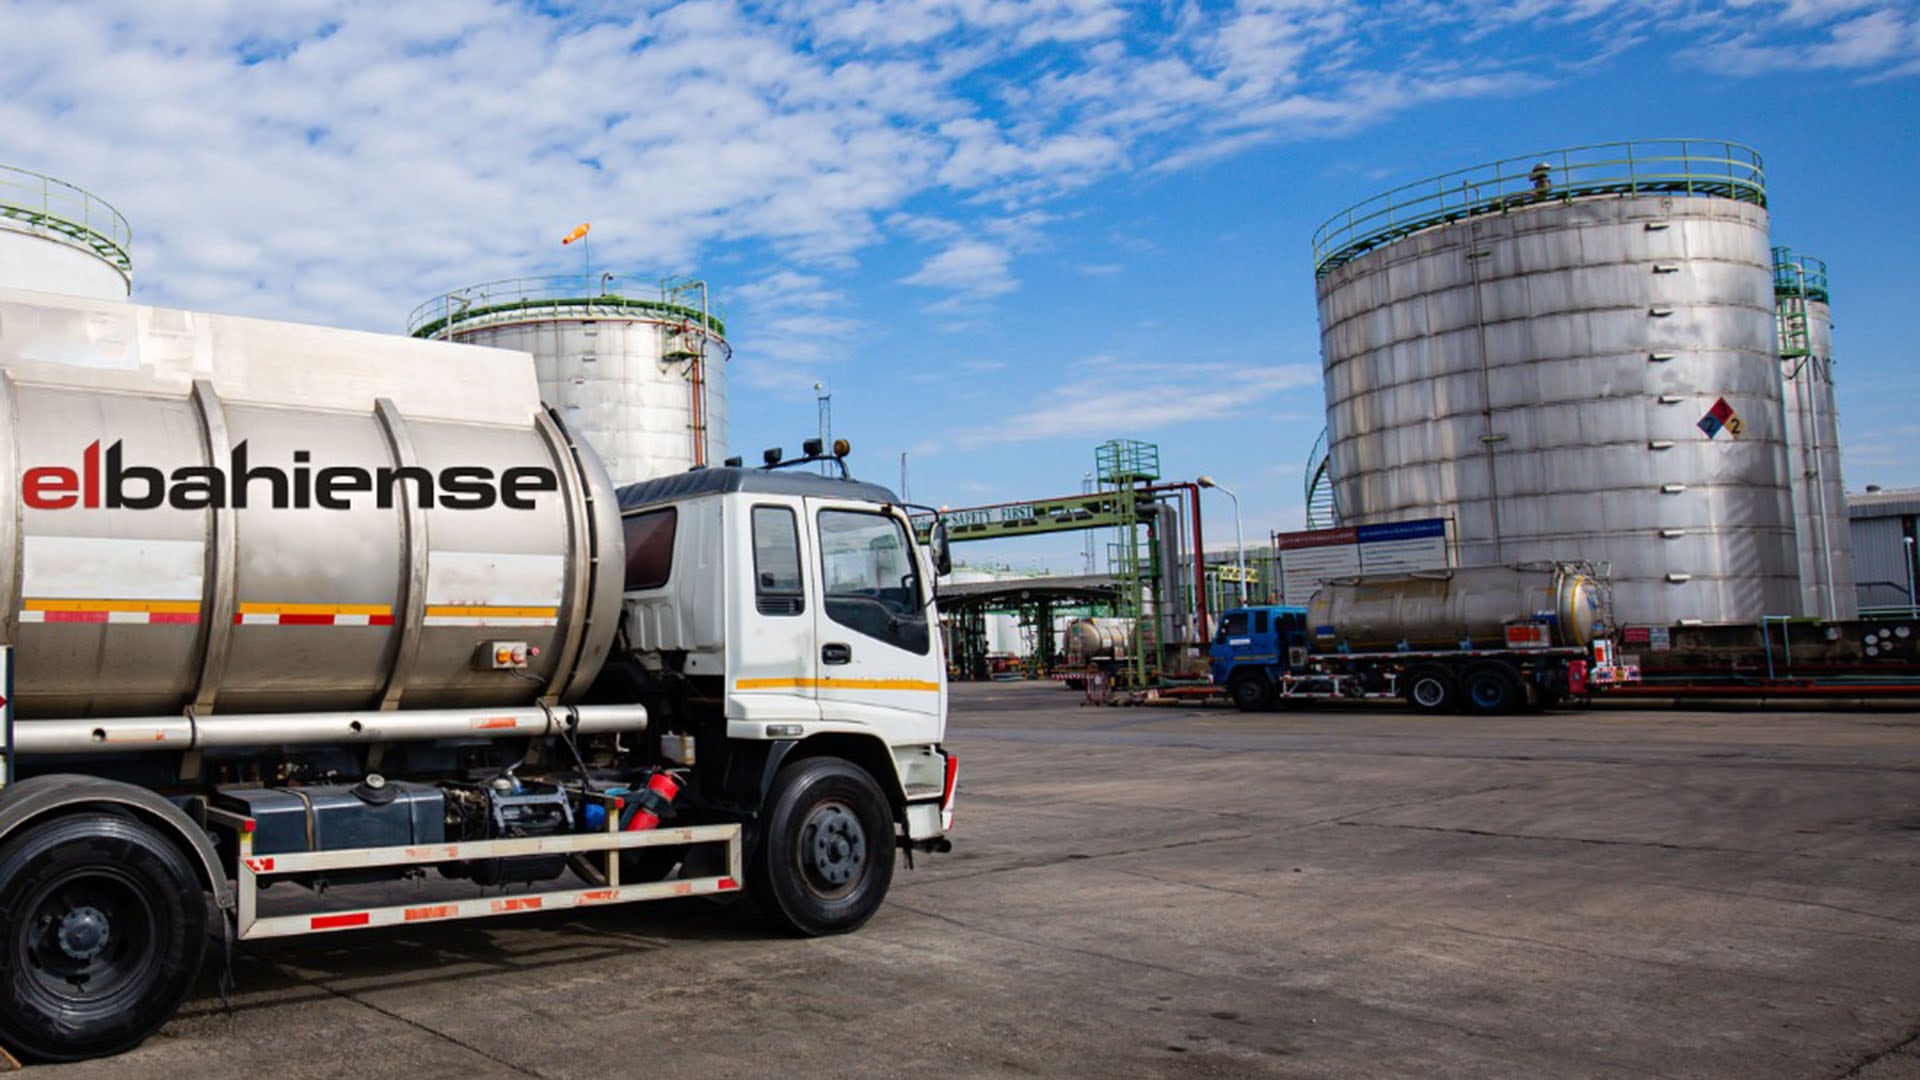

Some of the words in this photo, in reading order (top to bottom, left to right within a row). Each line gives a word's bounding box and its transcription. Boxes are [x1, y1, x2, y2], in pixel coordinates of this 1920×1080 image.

[1731, 418, 1741, 434] 2
[22, 438, 558, 510] elbahiense
[951, 510, 991, 526] SAFETY
[1001, 505, 1034, 521] FIRST
